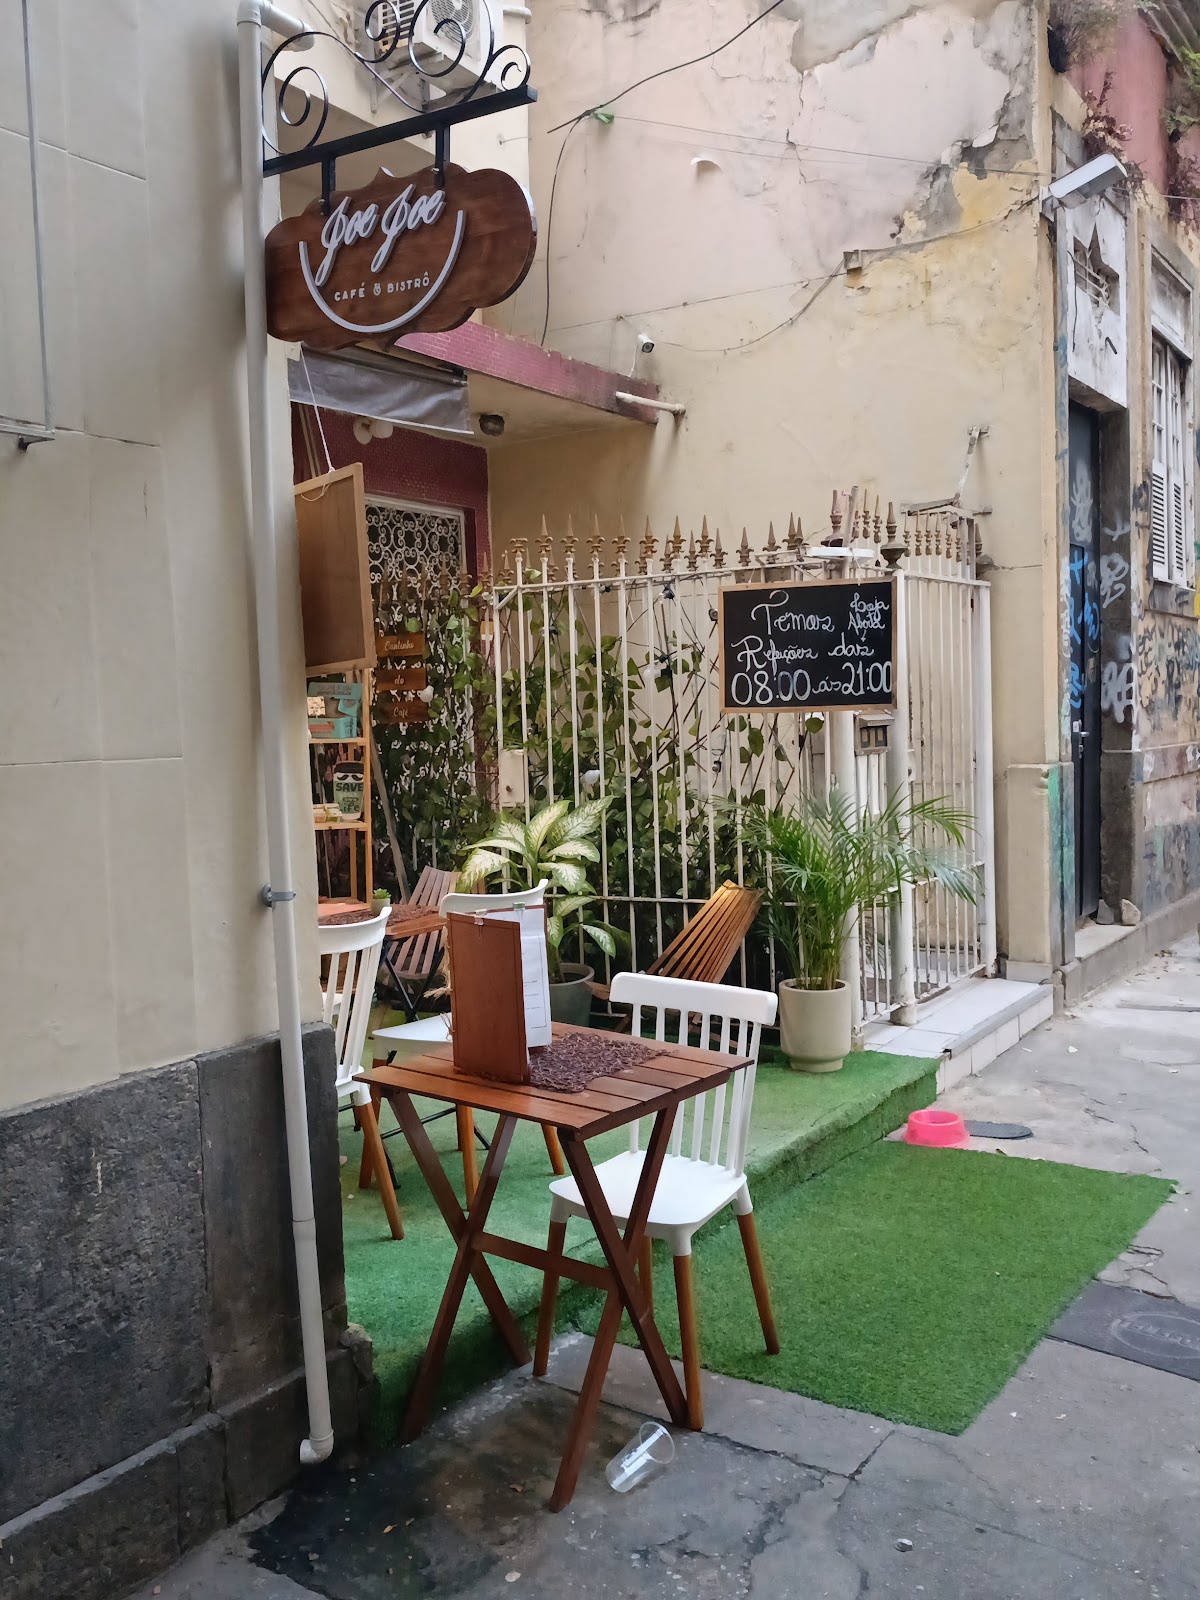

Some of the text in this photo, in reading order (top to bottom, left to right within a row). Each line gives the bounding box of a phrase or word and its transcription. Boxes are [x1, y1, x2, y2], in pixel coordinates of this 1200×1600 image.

[315, 184, 447, 287] Joe Joe
[334, 282, 366, 302] CAFÉ
[387, 271, 430, 291] BISTRÔ
[751, 590, 835, 635] Temos
[384, 640, 415, 652] Cantinho
[828, 632, 875, 657] das
[394, 674, 405, 685] do
[731, 669, 811, 706] 08:00
[841, 661, 893, 696] 21:00
[393, 707, 409, 718] Café
[335, 782, 364, 792] SAVE
